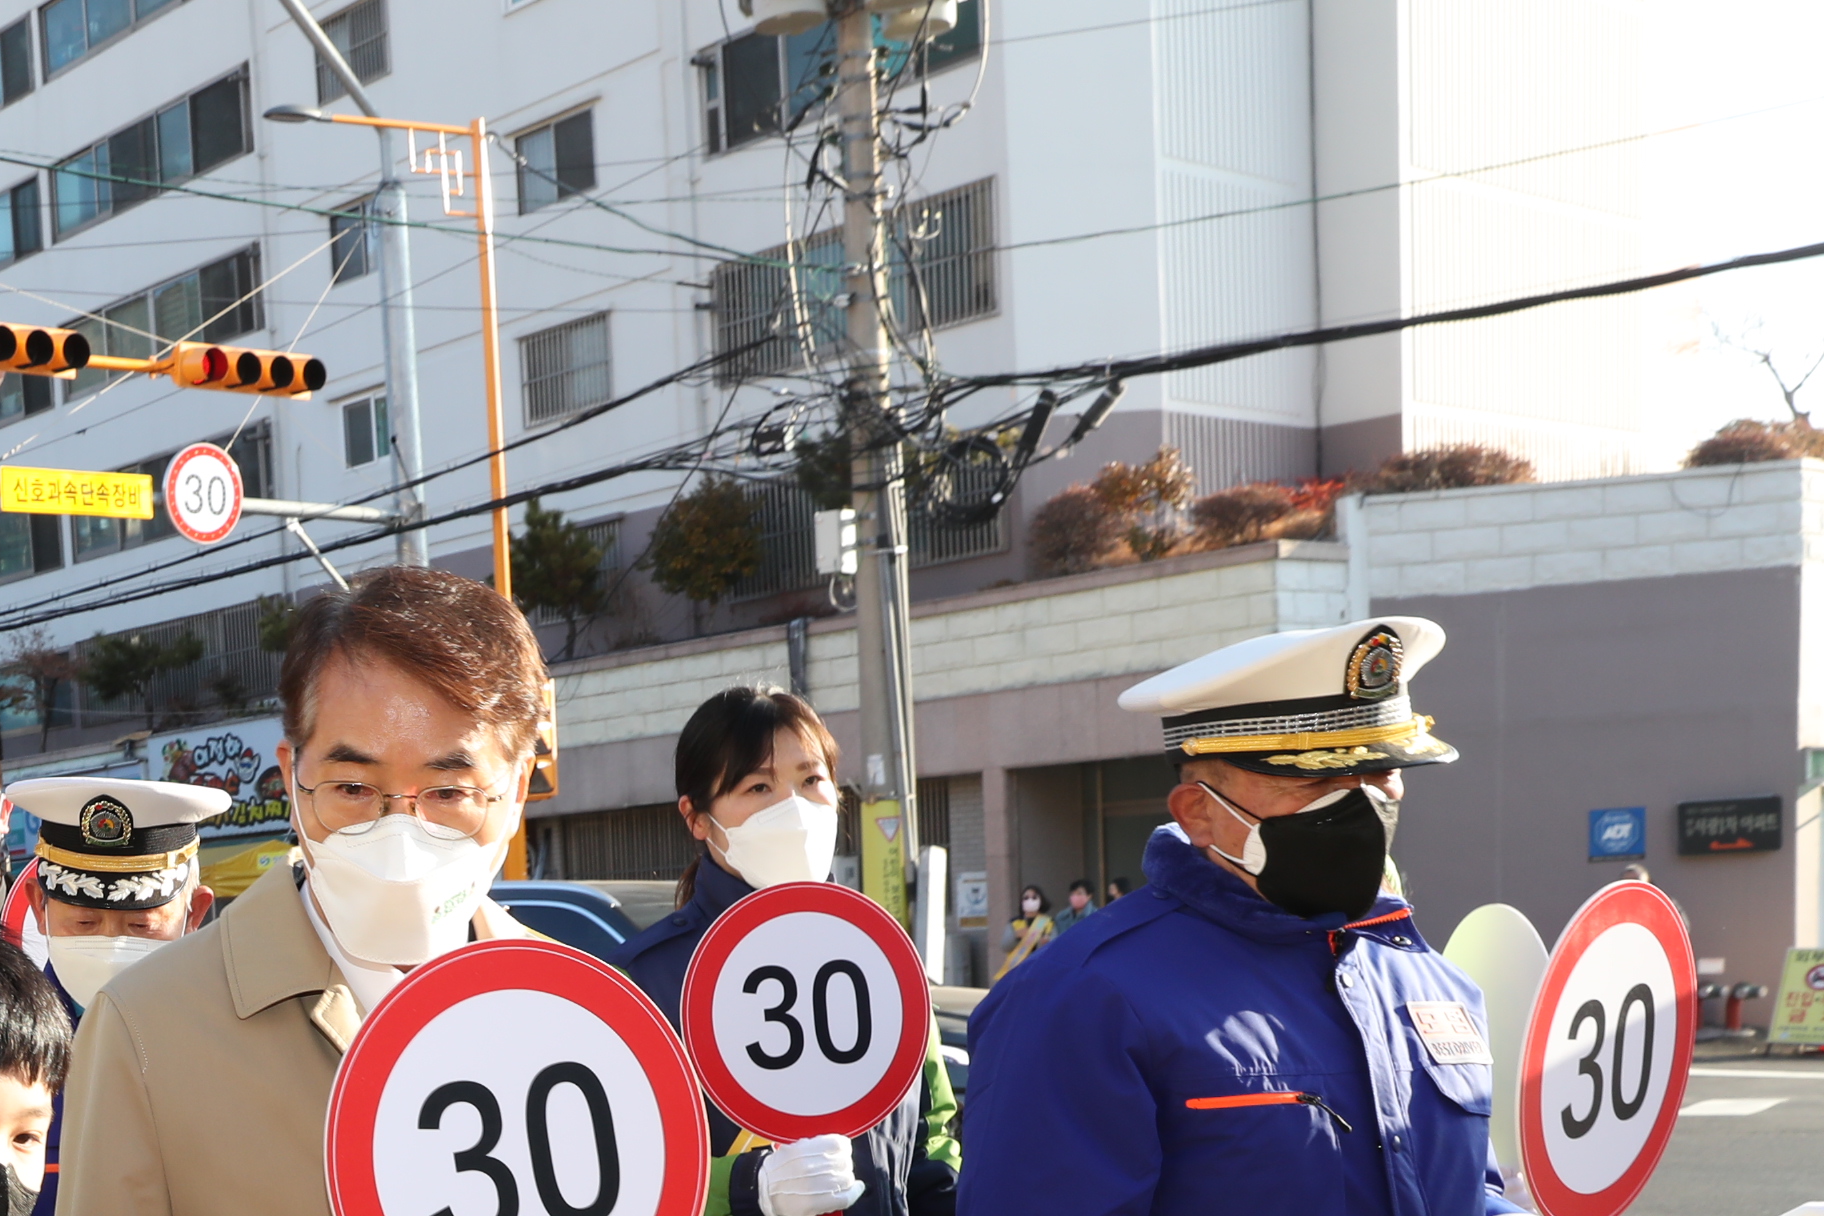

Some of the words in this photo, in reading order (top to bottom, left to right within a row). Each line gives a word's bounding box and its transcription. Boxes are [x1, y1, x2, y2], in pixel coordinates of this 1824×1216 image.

[14, 477, 141, 509] 신호과속단속장비
[184, 474, 227, 516] 30
[1601, 822, 1633, 841] ADT
[743, 960, 872, 1070] 30
[1562, 985, 1655, 1139] 30
